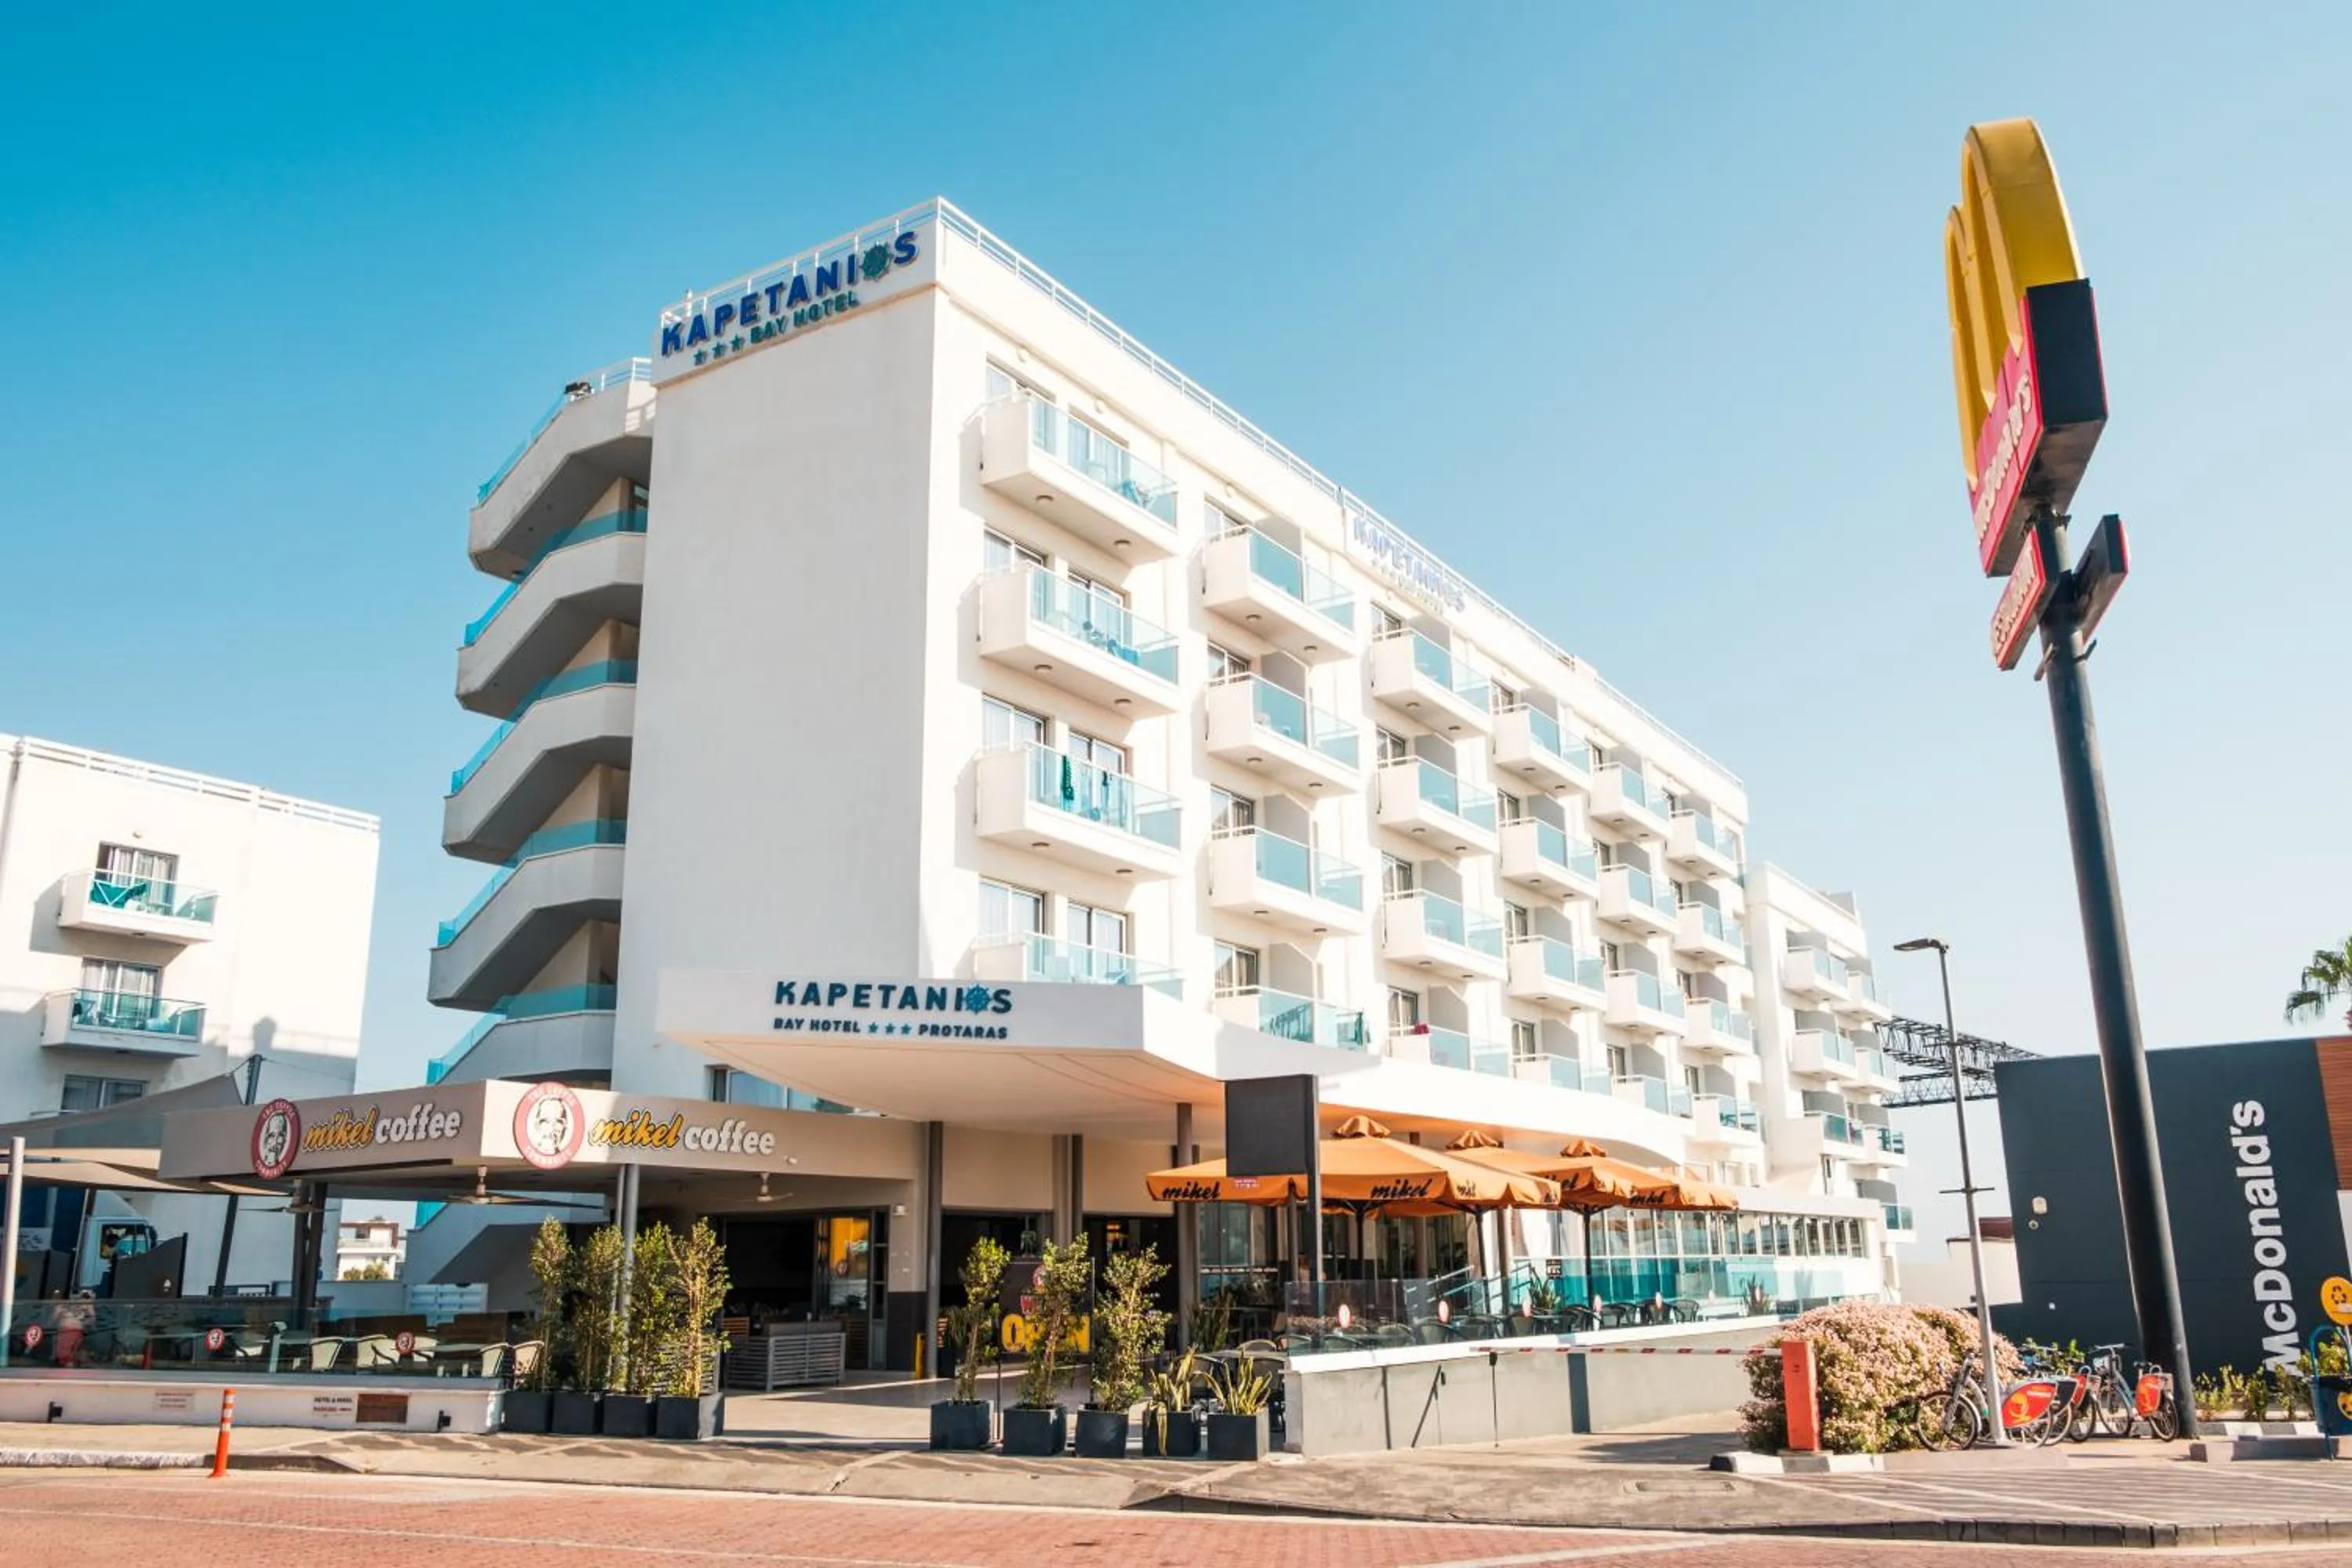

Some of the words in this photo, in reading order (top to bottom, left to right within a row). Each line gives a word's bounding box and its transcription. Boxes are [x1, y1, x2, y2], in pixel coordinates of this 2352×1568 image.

[750, 315, 789, 344] BAY
[793, 289, 860, 328] HOTEL
[773, 1017, 804, 1030] BAY
[810, 1018, 862, 1033] HOTEL
[918, 1023, 1008, 1040] PROTARAS
[301, 1104, 378, 1153] mikel
[375, 1103, 464, 1145] coffee
[588, 1108, 684, 1150] mikel
[684, 1119, 775, 1155] coffee
[1161, 1181, 1221, 1200] mikel
[1371, 1178, 1433, 1200] mikel
[2229, 1099, 2303, 1380] McDonald's
[1001, 1312, 1091, 1355] OPN
